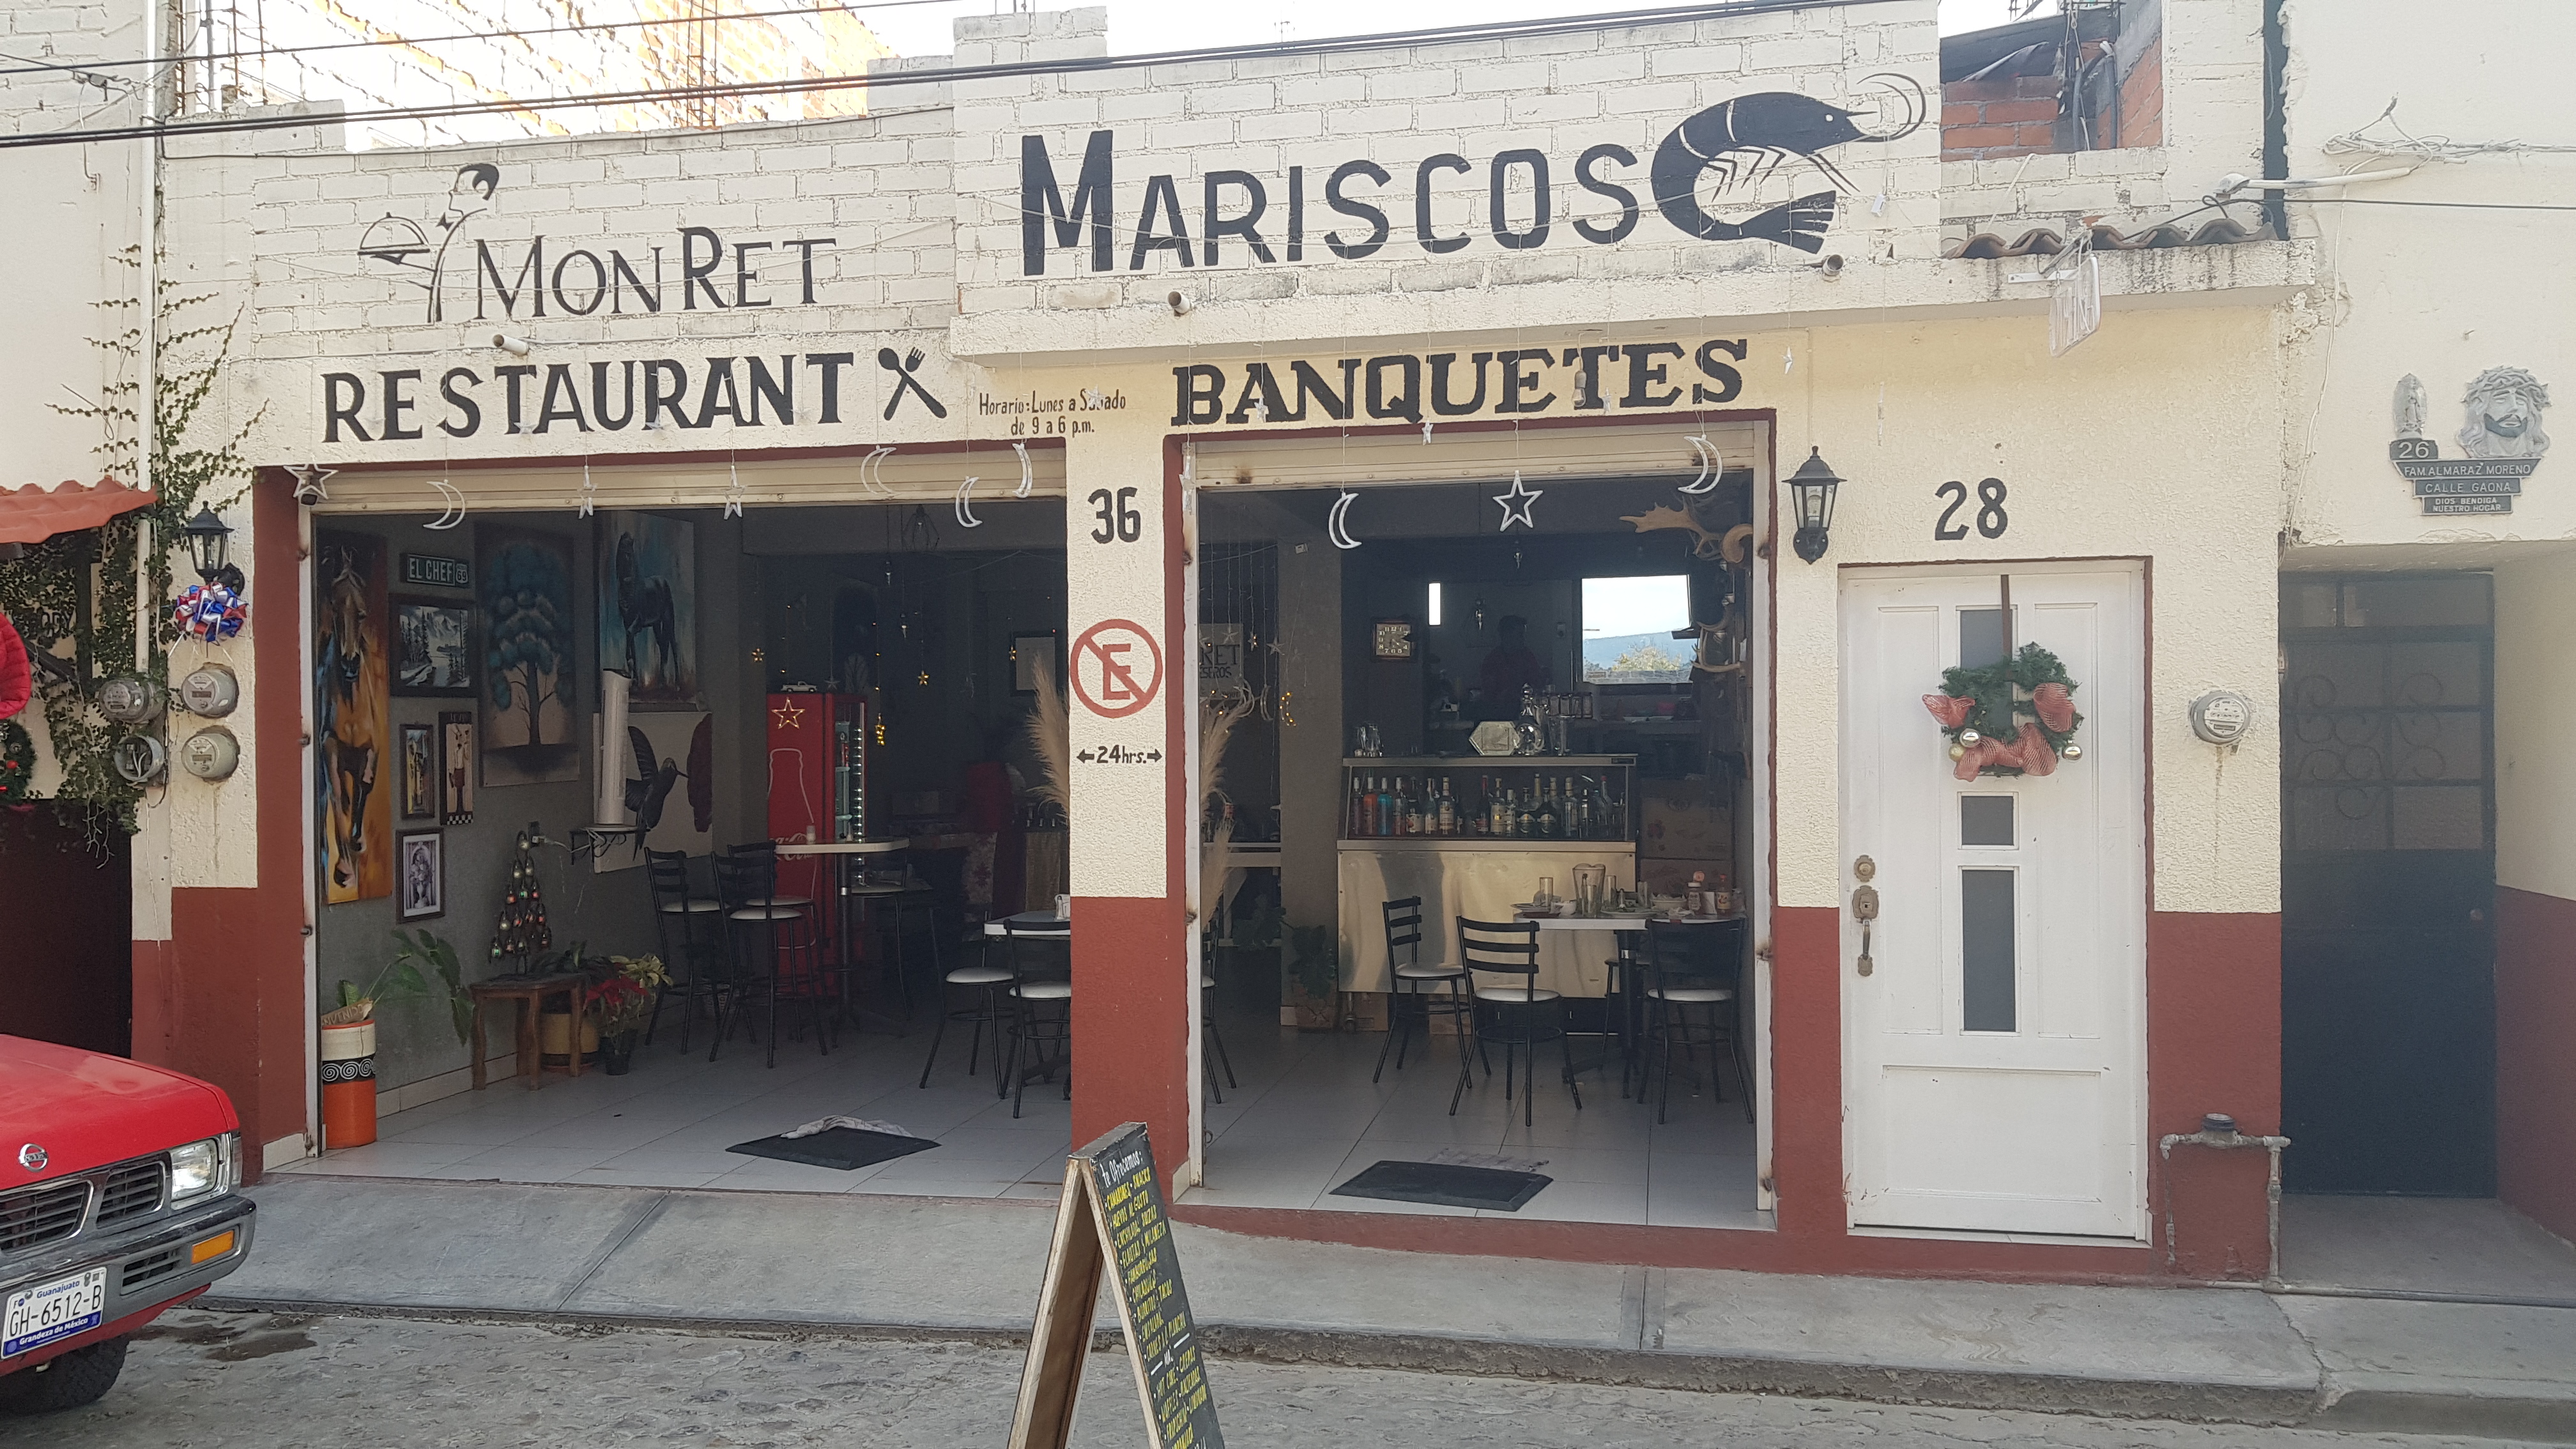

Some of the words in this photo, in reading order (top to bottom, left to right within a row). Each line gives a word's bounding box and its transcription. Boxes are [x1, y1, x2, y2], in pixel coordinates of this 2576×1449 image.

[1022, 129, 1639, 276] MARISCOS
[1170, 338, 1749, 427] BANQUETES
[321, 351, 854, 443] RESTAURANT
[1032, 390, 1064, 413] Lunes
[1068, 397, 1077, 411] a
[1080, 388, 1126, 411] Sado
[1011, 416, 1025, 436] de
[1032, 416, 1039, 434] 9
[1046, 420, 1053, 434] a
[1058, 415, 1066, 434] 6
[1072, 420, 1095, 438] p.m.
[2398, 441, 2430, 459] 26
[2428, 465, 2483, 476] ALMARAZ
[2486, 464, 2531, 475] MORENO
[2425, 483, 2464, 493] CALLE
[2471, 482, 2511, 492] GAONA
[1087, 487, 1141, 544] 36
[1935, 477, 2008, 540] 28
[410, 558, 423, 579] EL
[425, 560, 453, 582] CHEF
[457, 570, 466, 581] 69
[36, 1280, 80, 1299] Guanajuato
[10, 1285, 102, 1337] GH-6512-B
[19, 1330, 53, 1345] Grandeza
[54, 1324, 64, 1333] de
[64, 1317, 89, 1331] México
